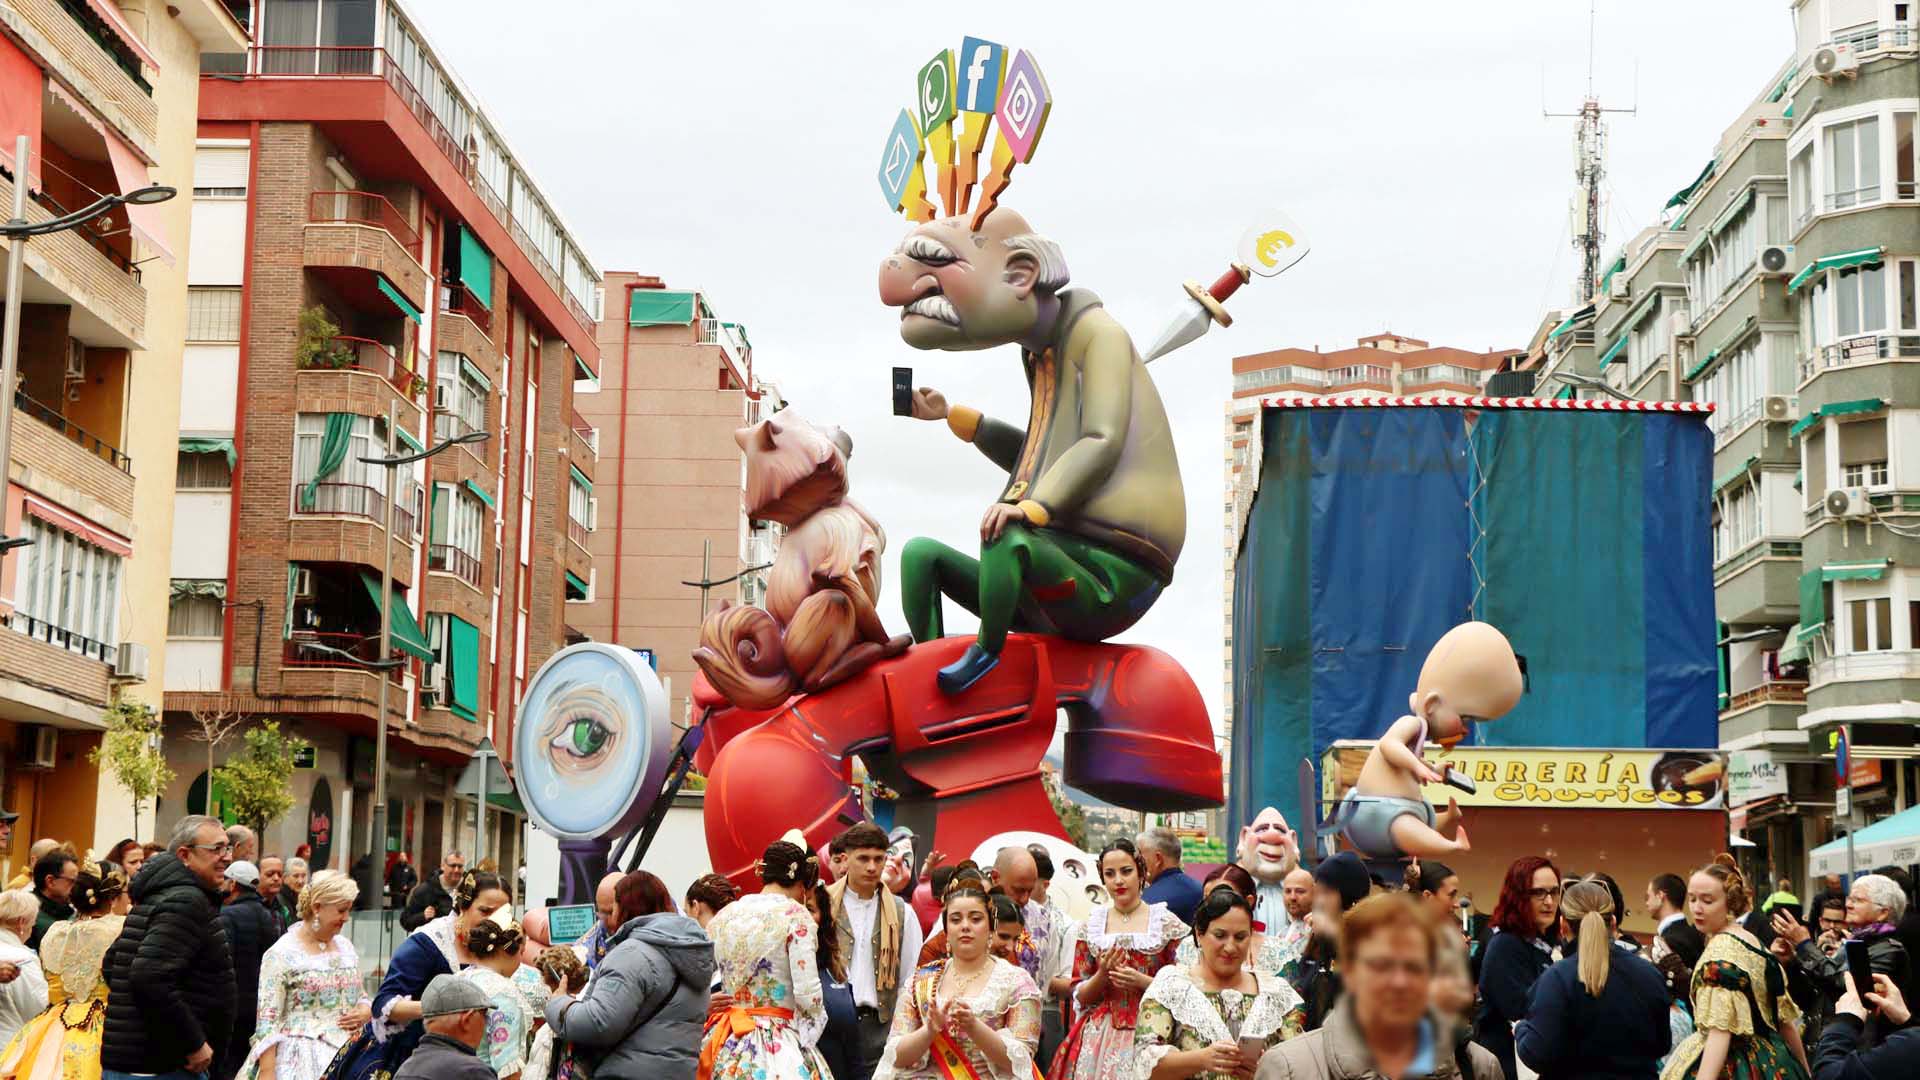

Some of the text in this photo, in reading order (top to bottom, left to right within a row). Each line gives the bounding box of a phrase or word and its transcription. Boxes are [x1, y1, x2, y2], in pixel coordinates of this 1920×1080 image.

[967, 45, 992, 111] f
[1493, 782, 1705, 803] Chu-ricos
[1066, 863, 1079, 879] 3
[1087, 888, 1102, 905] 2
